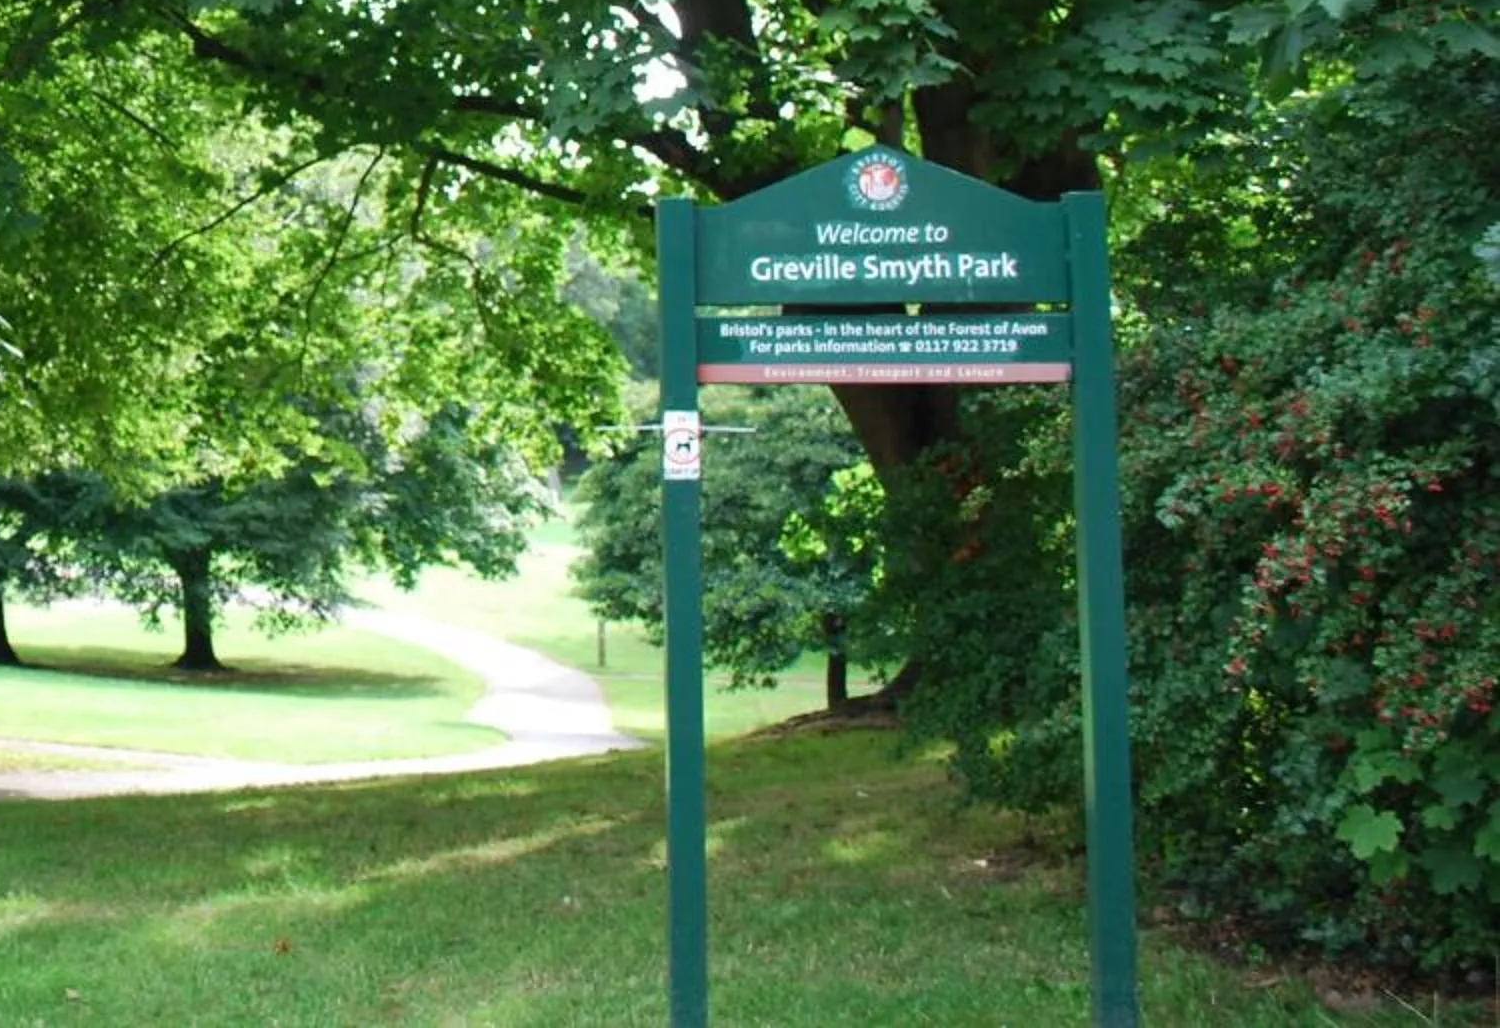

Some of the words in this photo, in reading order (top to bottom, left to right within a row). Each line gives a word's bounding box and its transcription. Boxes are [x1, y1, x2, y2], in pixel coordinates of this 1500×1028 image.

[816, 222, 918, 245] Welcome
[925, 222, 949, 243] to
[750, 254, 857, 282] Greville
[863, 253, 951, 285] Smyth
[957, 252, 1018, 278] Park
[719, 323, 773, 338] Bristol's
[775, 323, 813, 339] parks
[840, 322, 864, 337] the
[866, 322, 903, 337] heart
[905, 322, 920, 336] of
[922, 322, 946, 336] the
[948, 322, 991, 336] Forest
[993, 322, 1009, 336] of
[1011, 322, 1048, 336] Avon
[749, 339, 773, 354] For
[774, 339, 811, 356] parks
[814, 338, 896, 354] information
[914, 339, 950, 353] 0117
[952, 339, 979, 353] 922
[982, 339, 1018, 353] 3719
